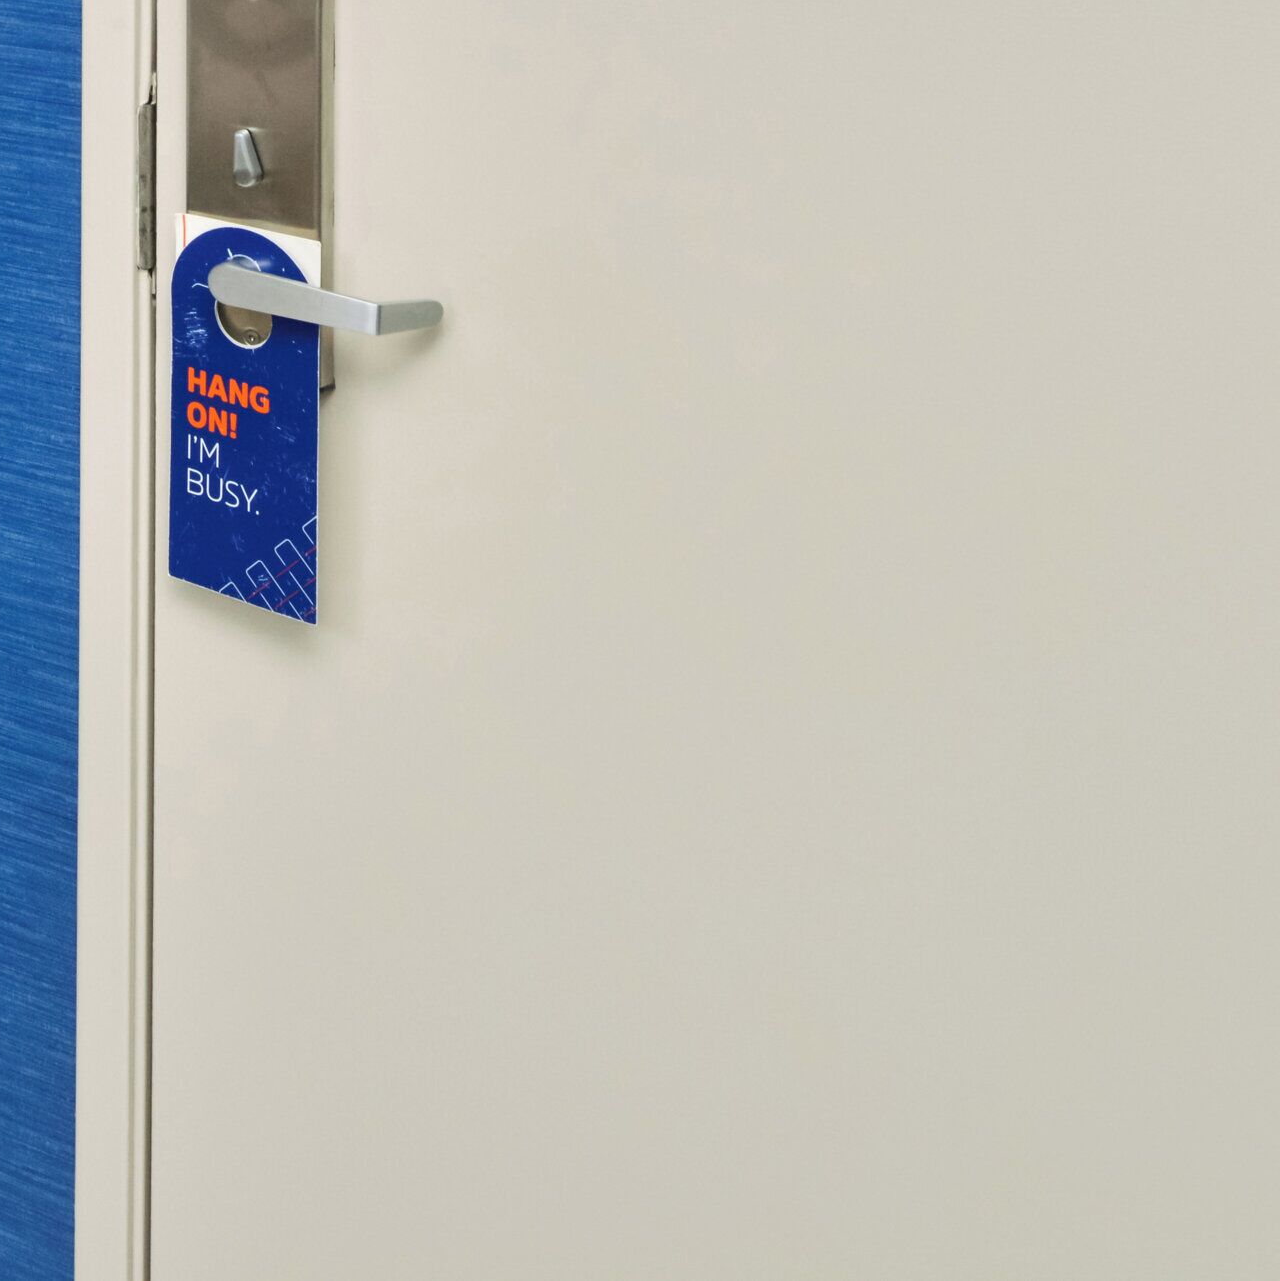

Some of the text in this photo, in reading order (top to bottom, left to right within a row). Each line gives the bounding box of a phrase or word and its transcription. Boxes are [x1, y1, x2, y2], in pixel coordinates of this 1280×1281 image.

[187, 367, 270, 414] HANG
[187, 401, 237, 439] ON!
[188, 434, 220, 468] I'M
[187, 467, 259, 515] BUSY.
